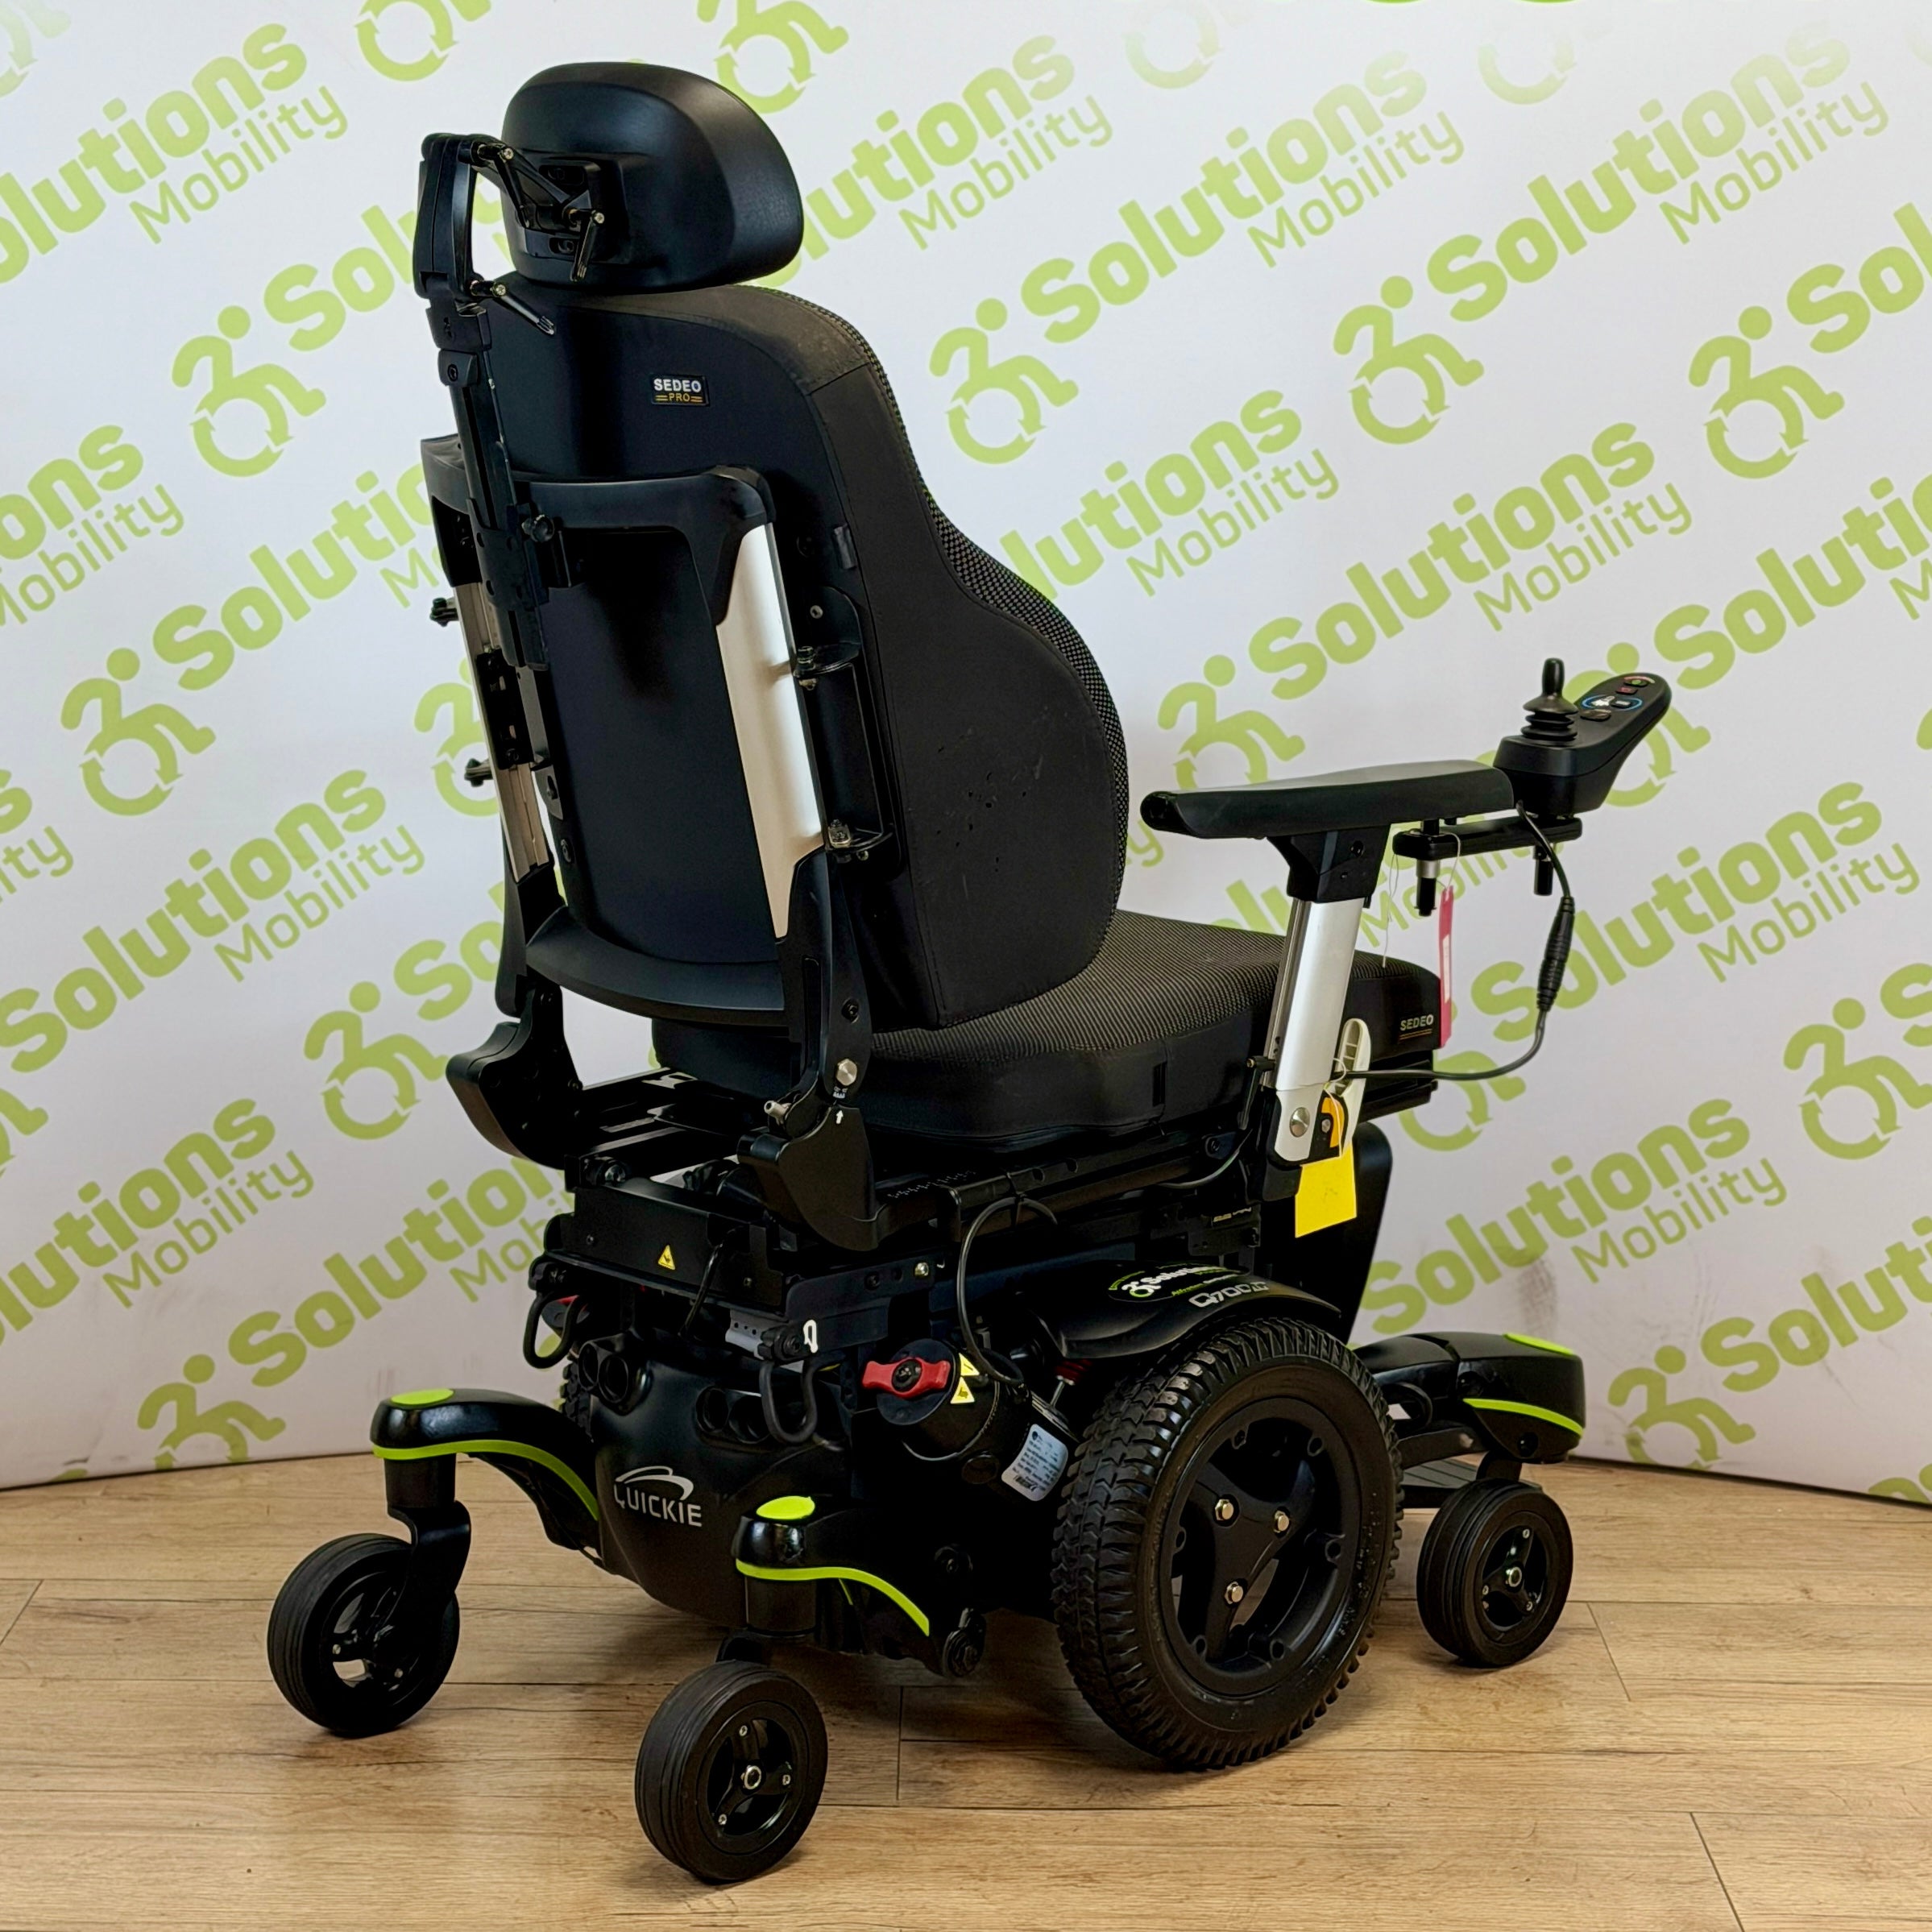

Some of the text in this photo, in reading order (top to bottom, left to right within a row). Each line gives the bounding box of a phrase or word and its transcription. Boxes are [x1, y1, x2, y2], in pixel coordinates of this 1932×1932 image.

[130, 86, 347, 243] Mobility
[899, 94, 1113, 250] Mobility
[1020, 49, 1427, 343] Solutions
[1247, 111, 1465, 267] Mobility
[1426, 20, 1851, 322] Solutions
[1659, 81, 1889, 244] Mobility
[653, 378, 702, 393] SEDEO
[669, 392, 690, 402] PRO
[1126, 450, 1339, 596] Mobility
[1248, 422, 1655, 701] Solutions
[1474, 483, 1692, 632] Mobility
[0, 770, 385, 1074] Solutions
[214, 826, 424, 981] Mobility
[1697, 844, 1920, 983] Mobility
[1399, 1014, 1434, 1031] SEDEO
[0, 1098, 276, 1346] lutions
[102, 1151, 314, 1309] Mobility
[1359, 1099, 1750, 1336] Solutions
[1571, 1159, 1787, 1284] Mobility
